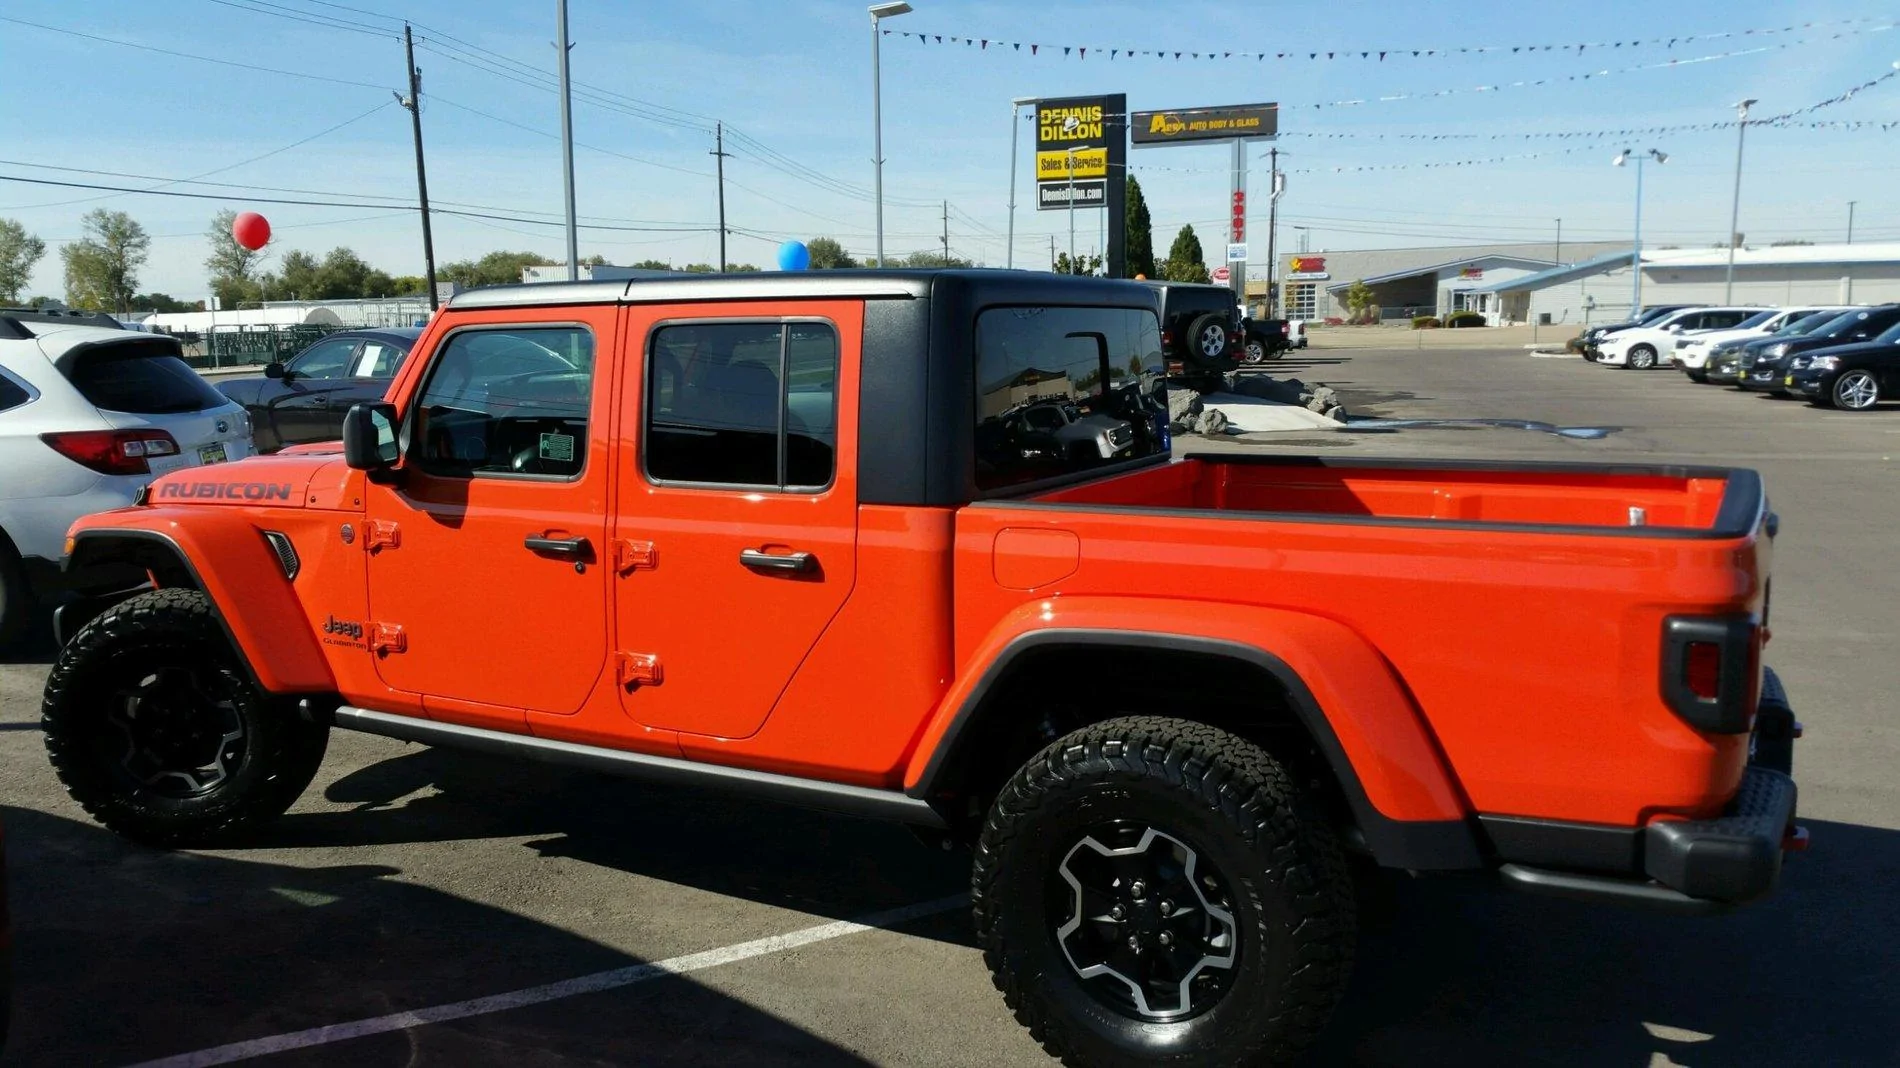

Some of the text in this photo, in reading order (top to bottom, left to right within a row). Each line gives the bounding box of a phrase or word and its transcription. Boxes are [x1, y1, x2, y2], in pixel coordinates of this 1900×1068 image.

[1040, 106, 1102, 124] DENNIS
[1041, 123, 1102, 141] DILLON
[1189, 122, 1207, 131] AUTO
[1209, 120, 1227, 129] BODY
[1236, 118, 1259, 127] GLASS
[1041, 156, 1103, 171] Sales & Service
[1042, 188, 1102, 201] DennisDllon.com
[159, 482, 292, 500] RUBICON
[322, 614, 363, 641] Jeep
[323, 637, 366, 650] GLADIATOR
